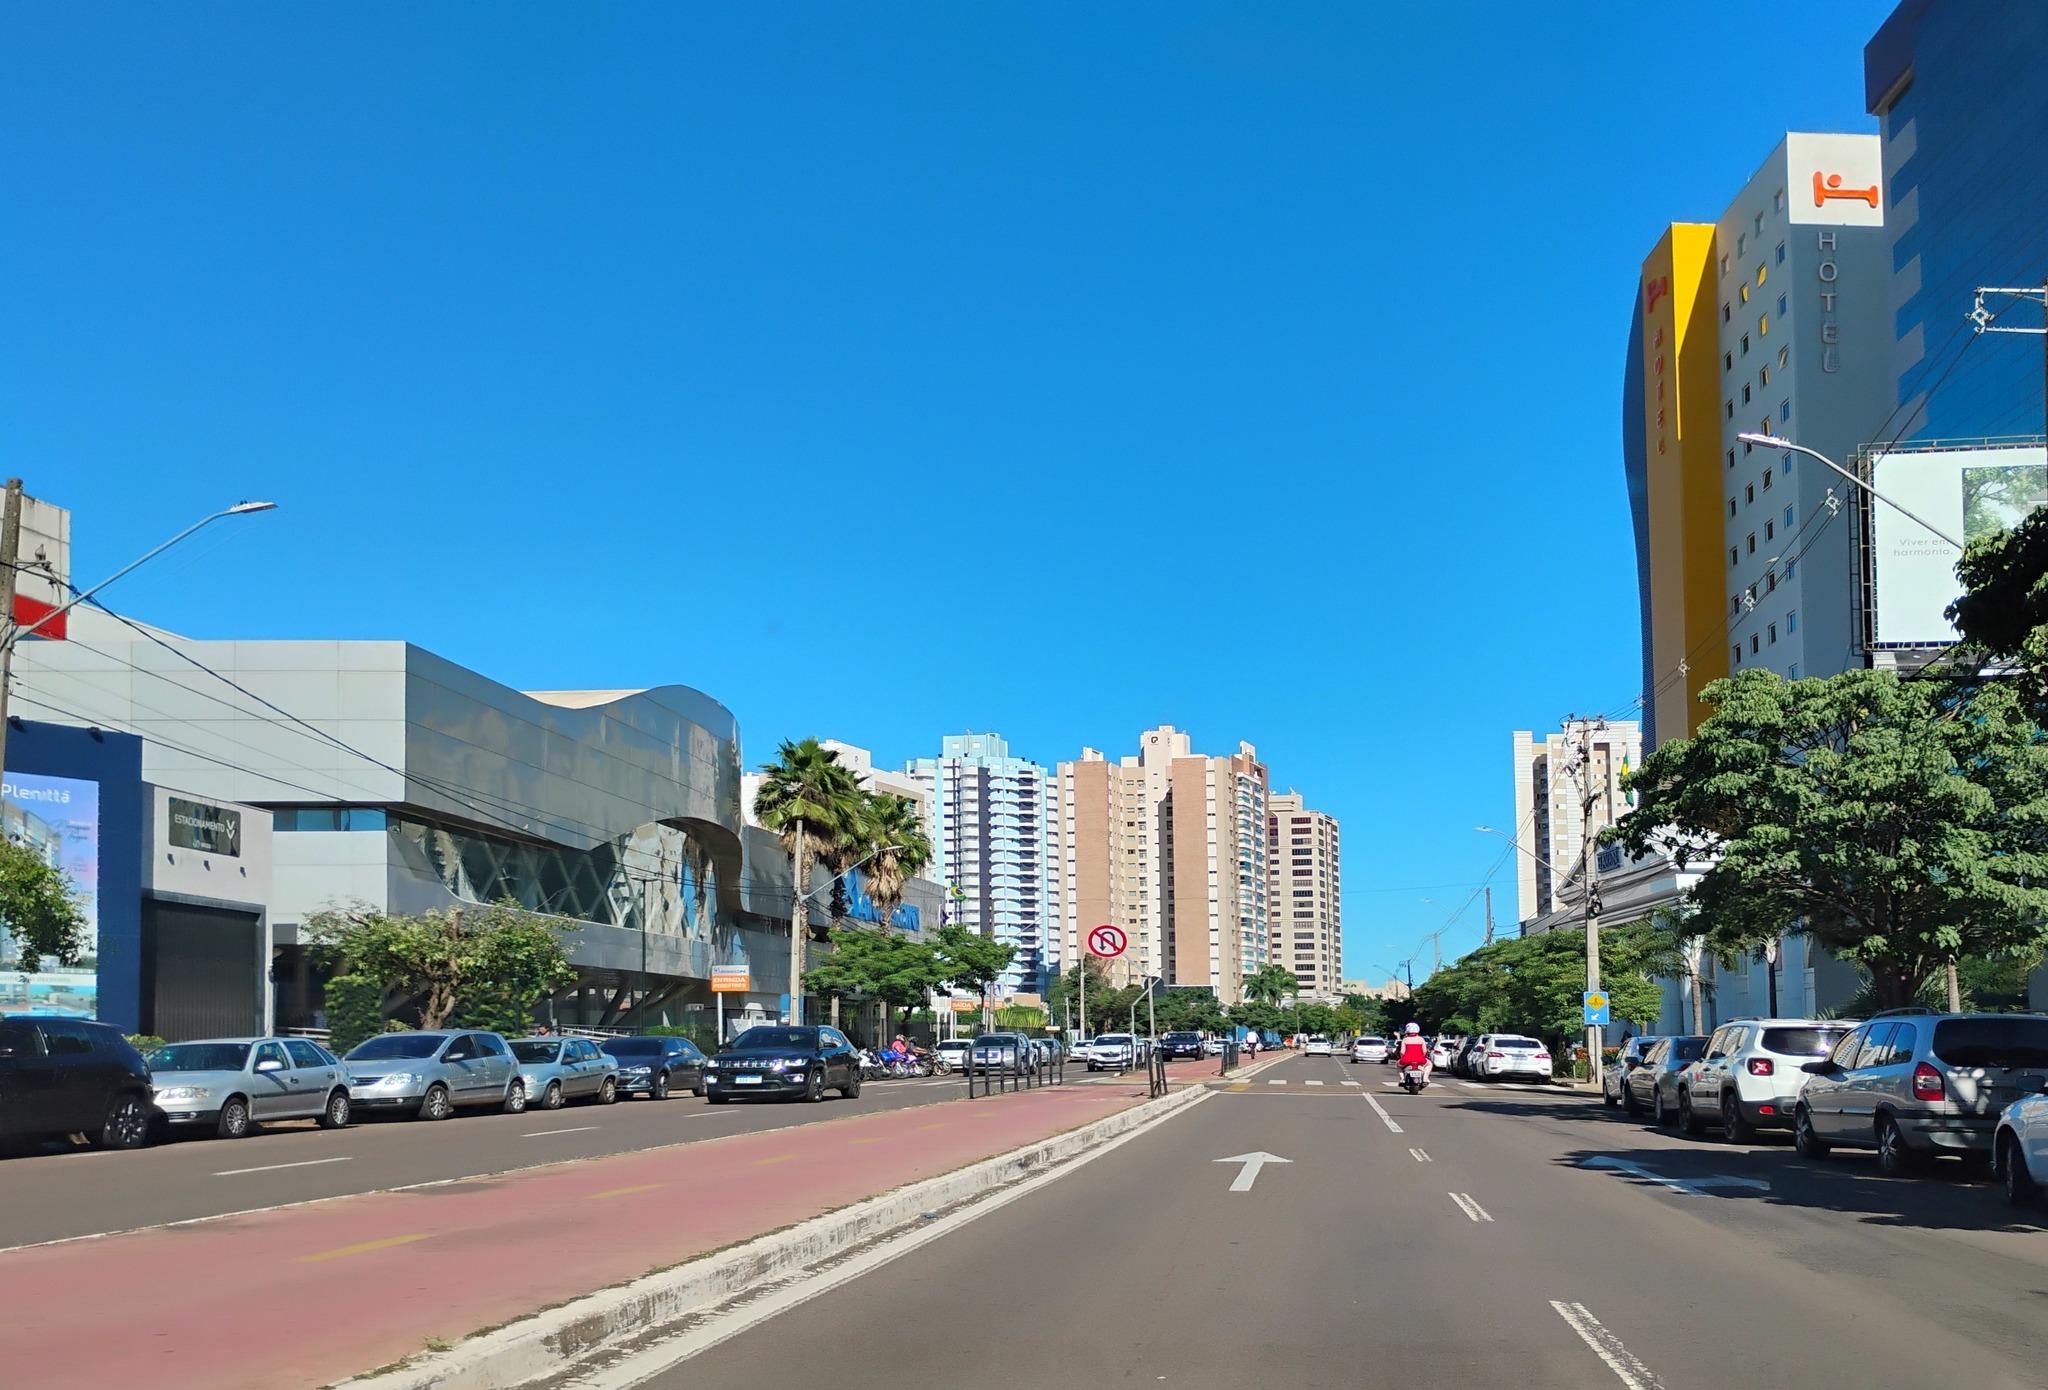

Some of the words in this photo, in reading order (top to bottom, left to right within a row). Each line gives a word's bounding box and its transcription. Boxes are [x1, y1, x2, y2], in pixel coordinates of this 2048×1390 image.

[1818, 231, 1838, 373] HOTEL
[1899, 538, 1928, 546] Viver
[174, 813, 225, 832] ESTACIONAMENTO
